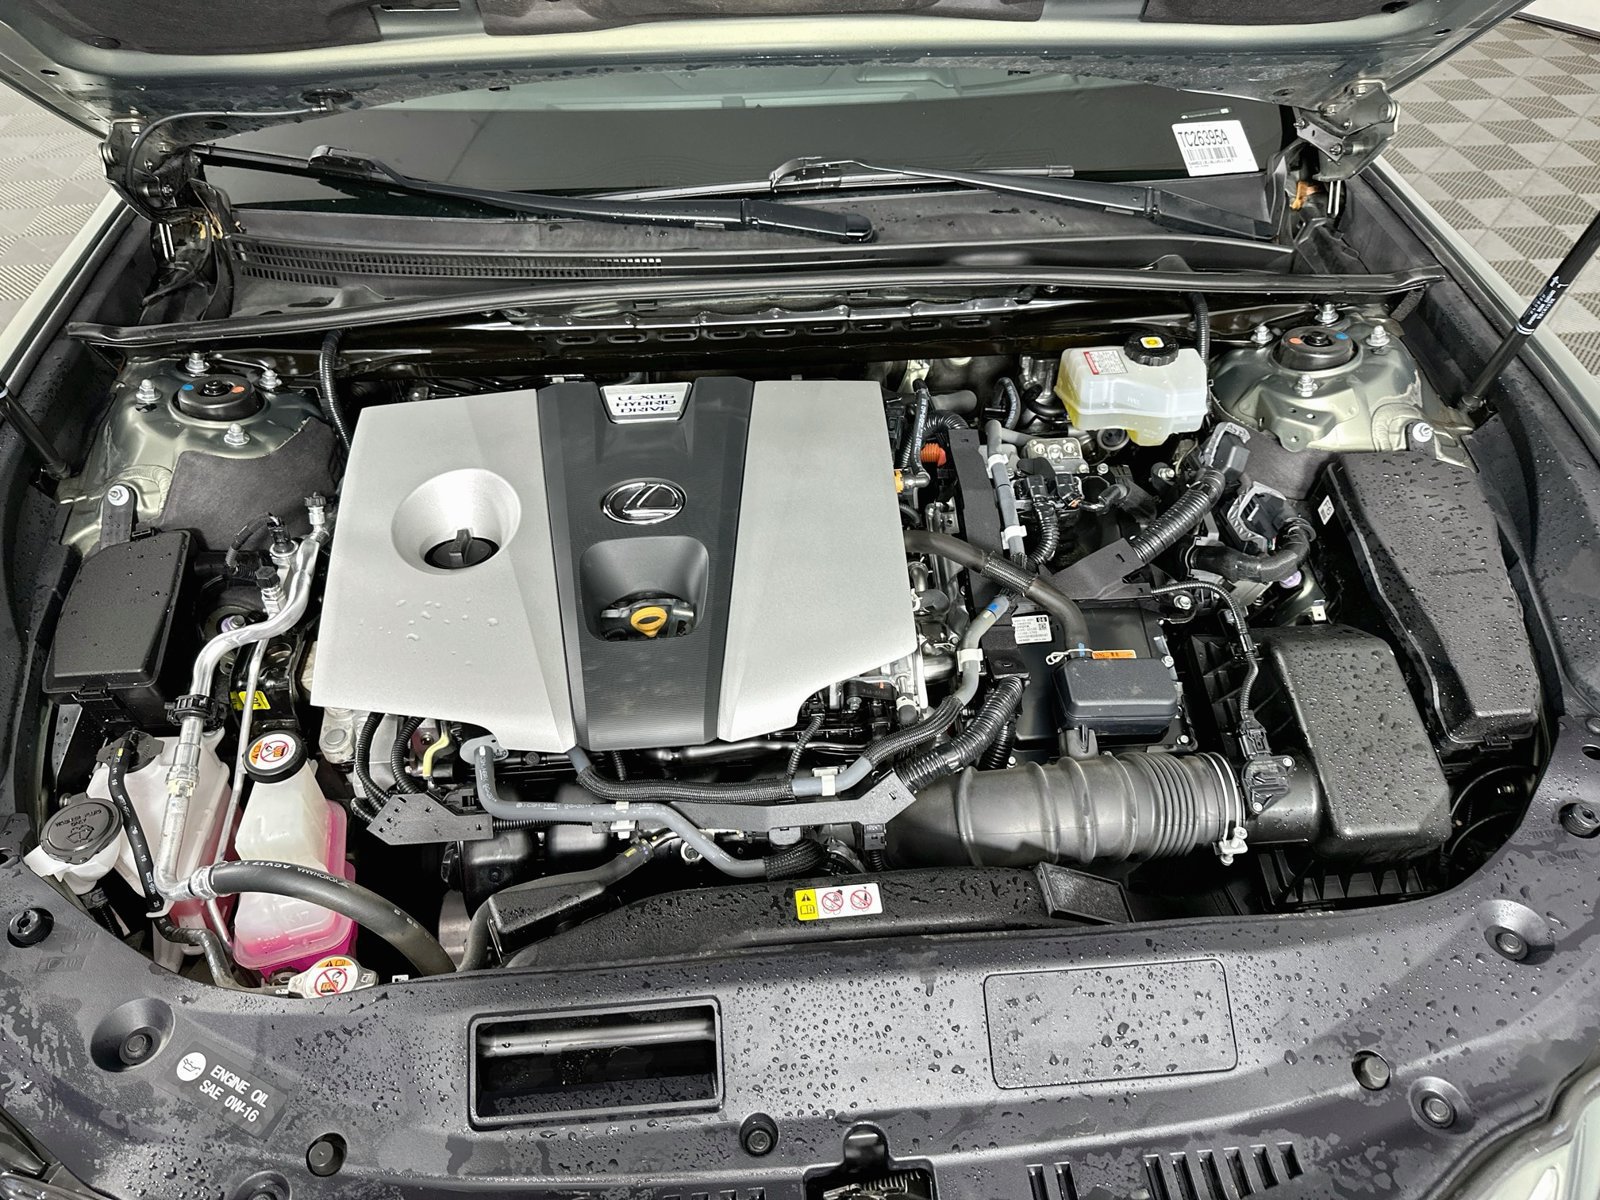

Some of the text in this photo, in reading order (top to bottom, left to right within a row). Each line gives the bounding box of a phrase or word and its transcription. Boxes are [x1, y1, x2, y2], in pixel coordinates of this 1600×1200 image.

[1177, 129, 1230, 148] TC26395A
[199, 1079, 260, 1123] SAE 0W-16
[210, 1064, 269, 1108] ENGINE OIL
